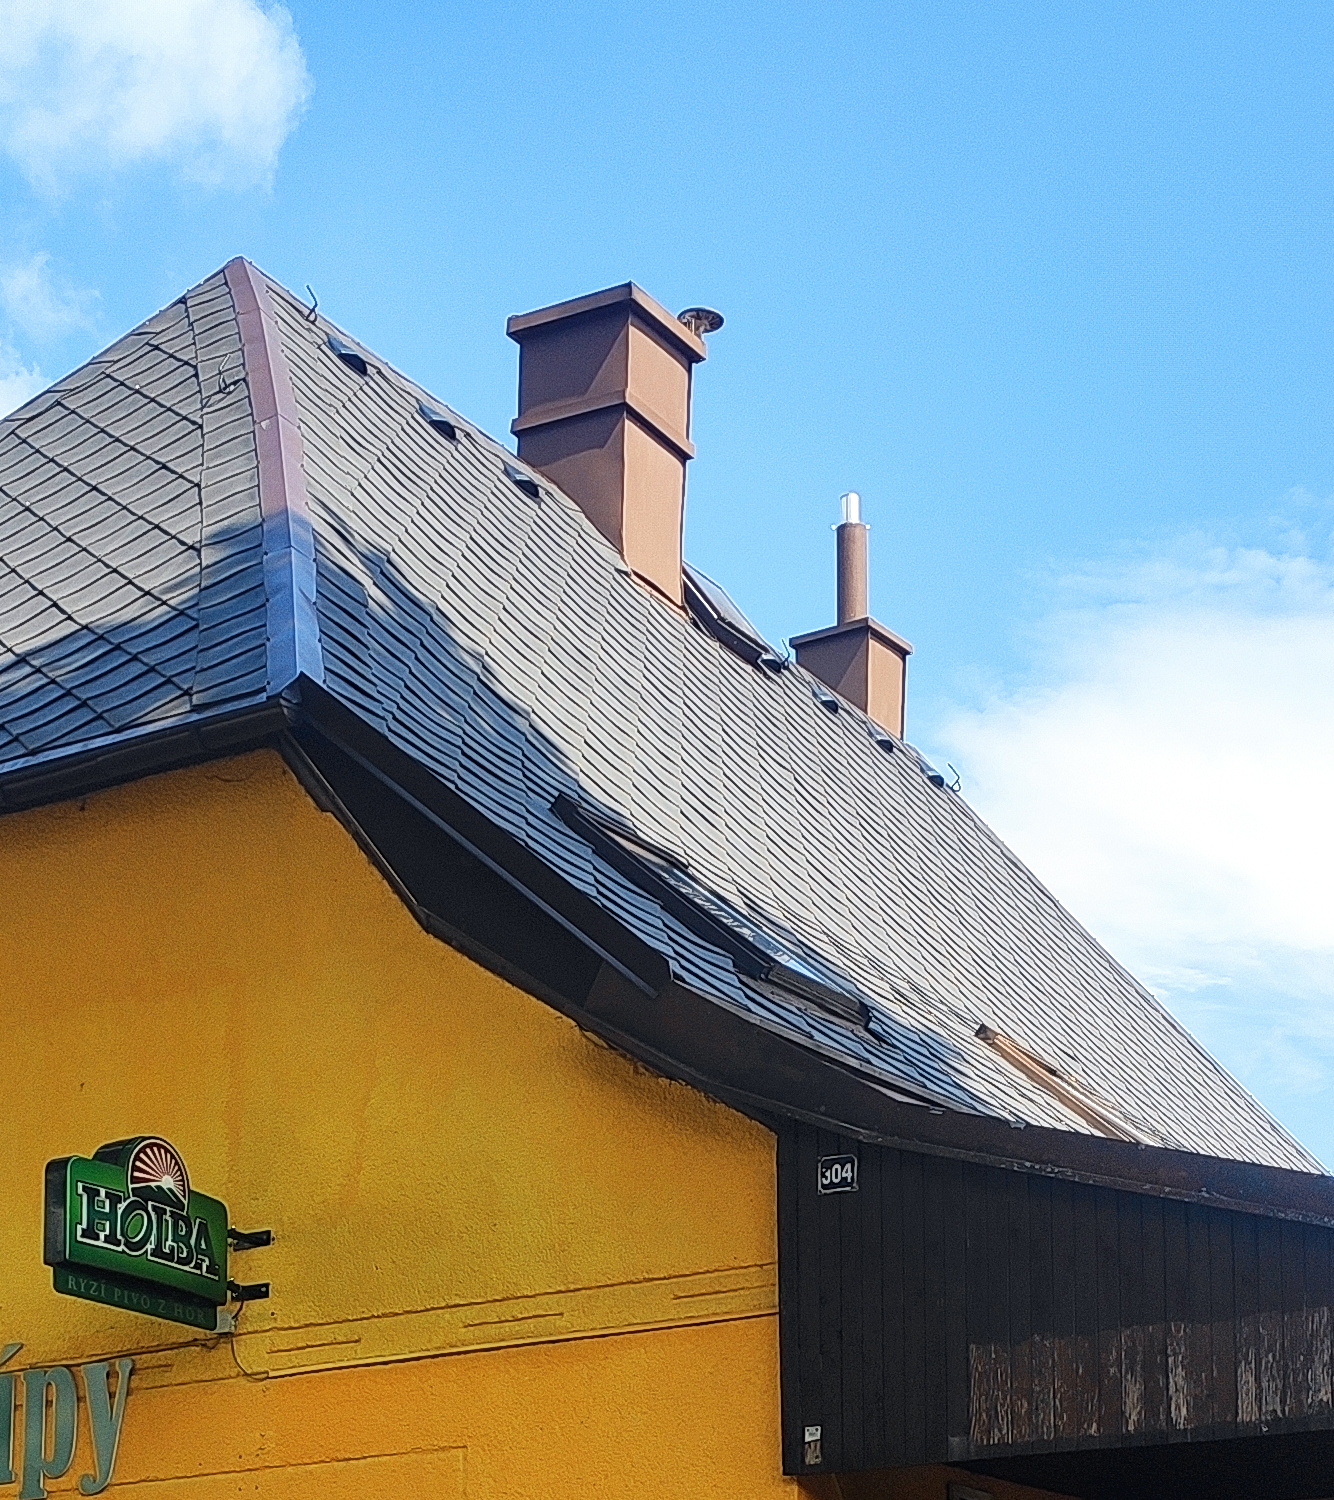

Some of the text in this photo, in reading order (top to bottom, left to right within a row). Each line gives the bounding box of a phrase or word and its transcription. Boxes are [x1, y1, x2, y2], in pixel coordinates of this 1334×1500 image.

[821, 1162, 853, 1185] 304
[75, 1181, 219, 1281] HOLBA
[113, 1287, 151, 1309] PIVO
